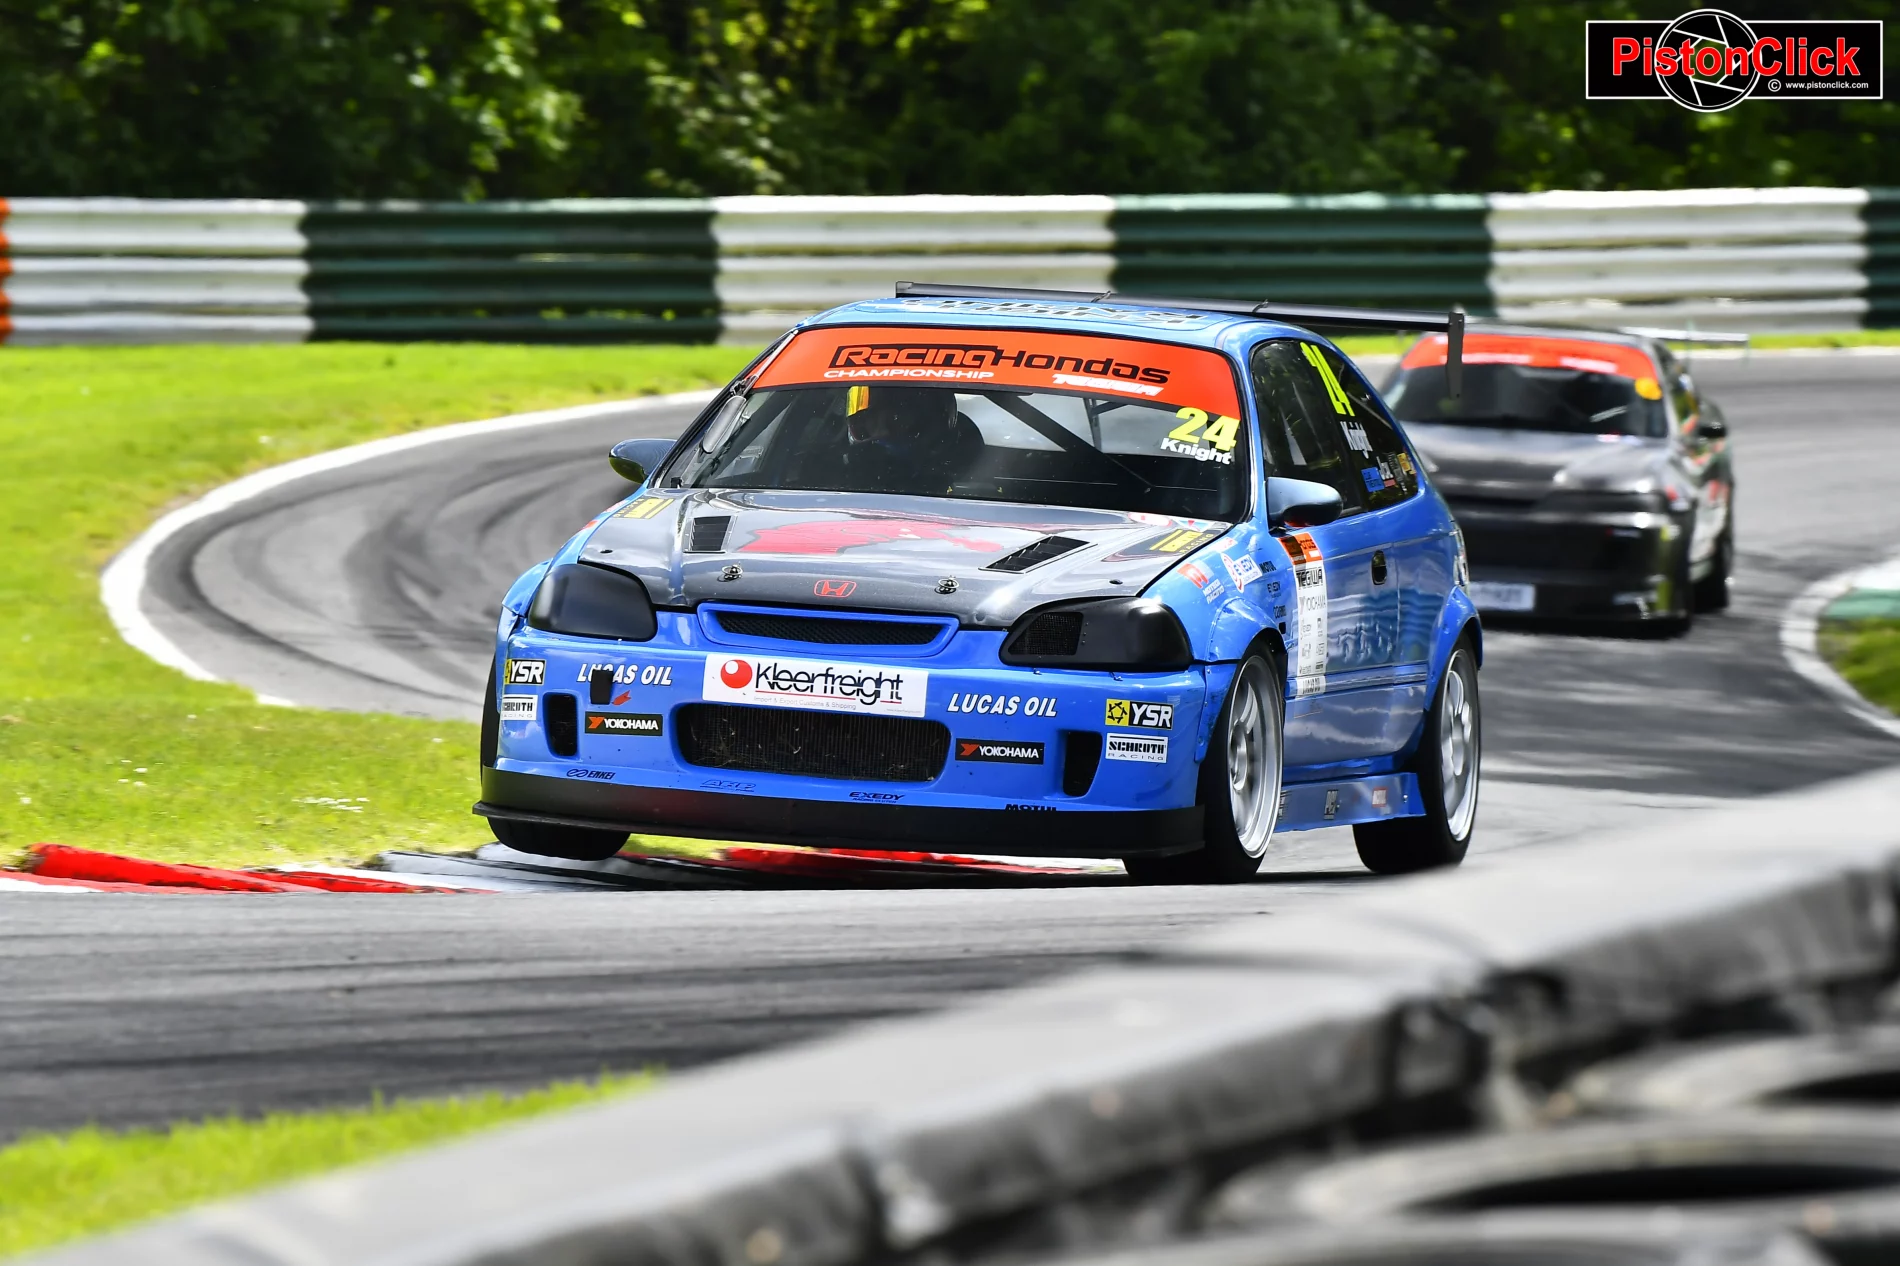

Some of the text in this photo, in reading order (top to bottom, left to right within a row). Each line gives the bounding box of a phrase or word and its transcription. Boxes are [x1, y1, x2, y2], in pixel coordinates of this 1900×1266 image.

[824, 368, 995, 379] CHAMPIONSHIP
[1168, 407, 1241, 451] 24
[1160, 437, 1232, 465] Knight
[510, 660, 545, 684] YSR
[640, 665, 673, 686] OIL
[755, 662, 904, 706] Kleerfreight
[779, 698, 798, 706] Export
[798, 699, 824, 707] Customs
[831, 702, 856, 711] Shipping
[947, 693, 1058, 718] LUCAS OIL
[1131, 702, 1172, 728] YSR
[604, 718, 659, 731] YOKOHAMA
[979, 745, 1039, 758] YOKOHAMA
[1108, 741, 1165, 754] SCHROTH
[1107, 753, 1164, 761] RACING
[588, 770, 616, 780] ENKEI
[849, 791, 905, 801] EXEDY
